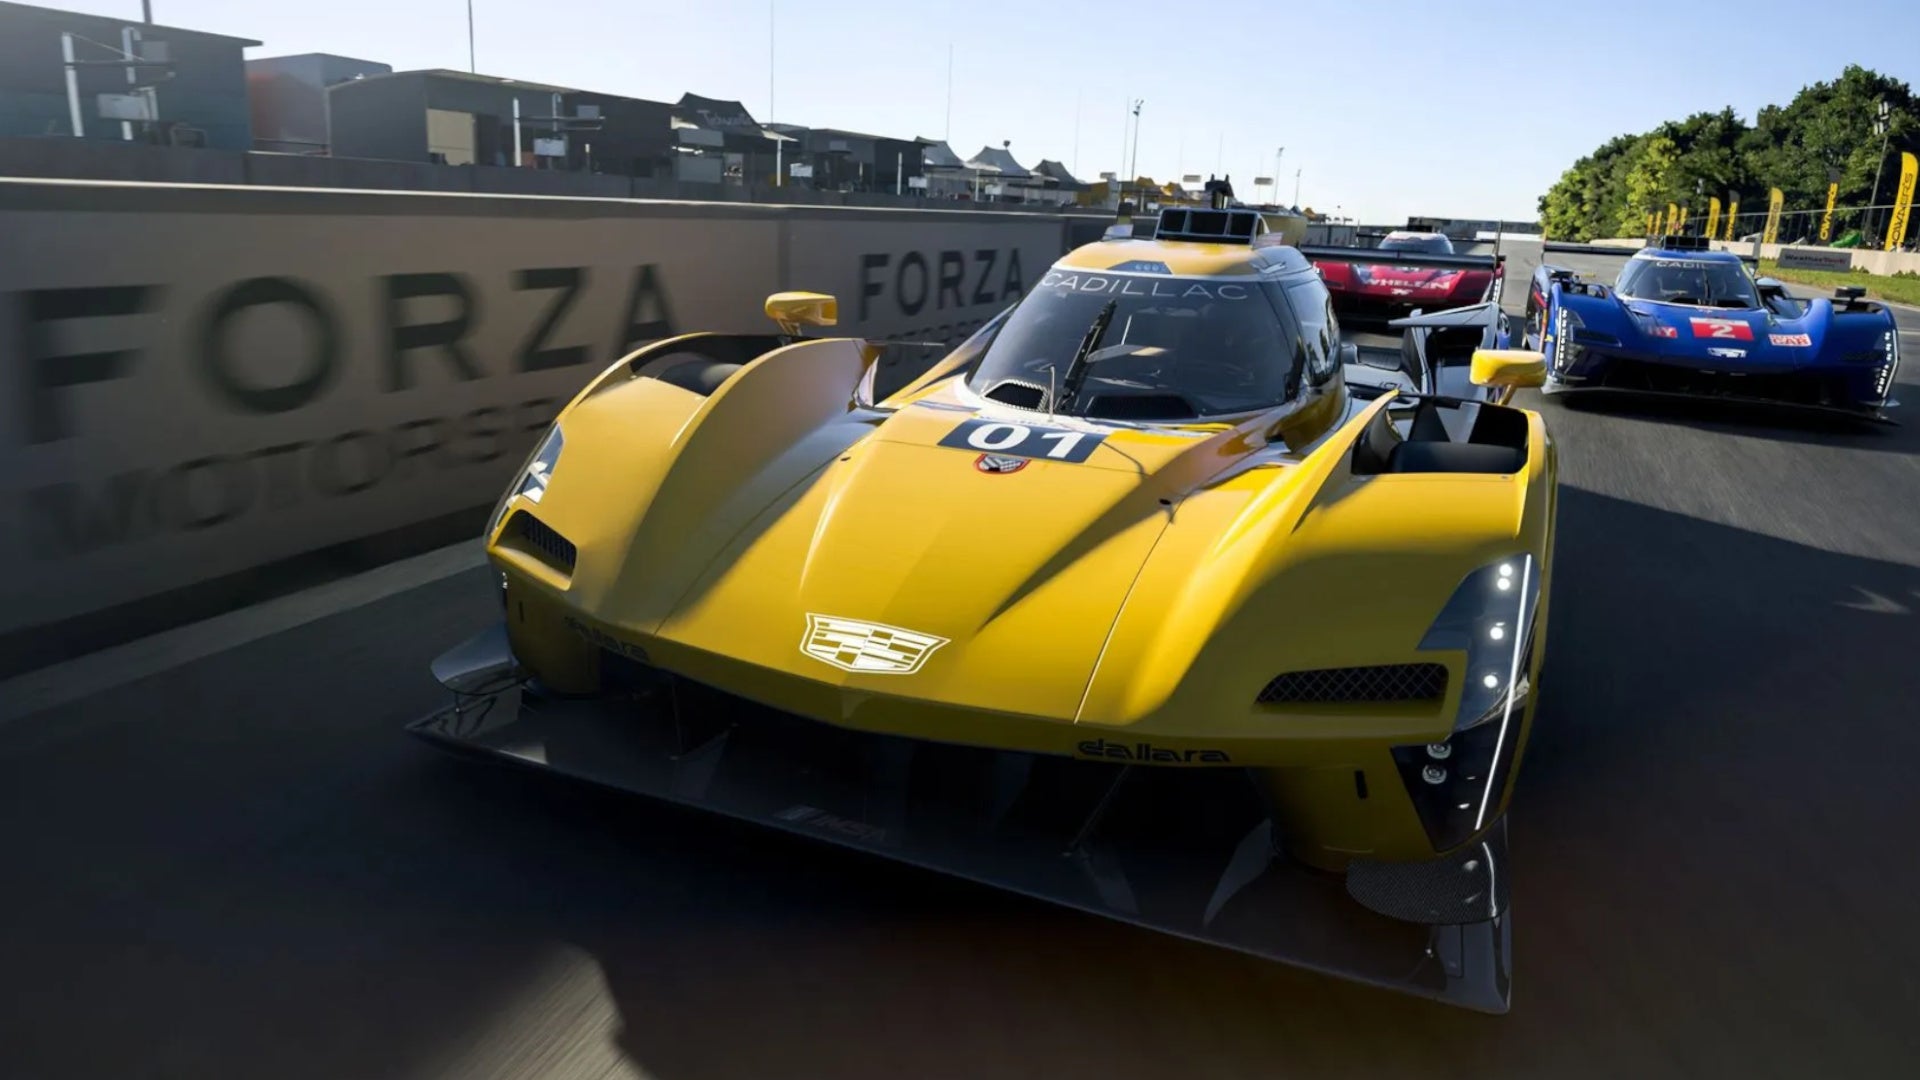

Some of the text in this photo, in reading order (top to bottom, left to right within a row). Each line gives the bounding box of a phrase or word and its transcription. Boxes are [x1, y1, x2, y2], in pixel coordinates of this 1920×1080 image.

[860, 247, 1023, 321] FORZA
[1042, 272, 1249, 300] CADILLAC
[1709, 324, 1736, 338] 2
[17, 263, 678, 446] FORZA
[966, 422, 1087, 459] 01
[1077, 738, 1231, 763] dallara
